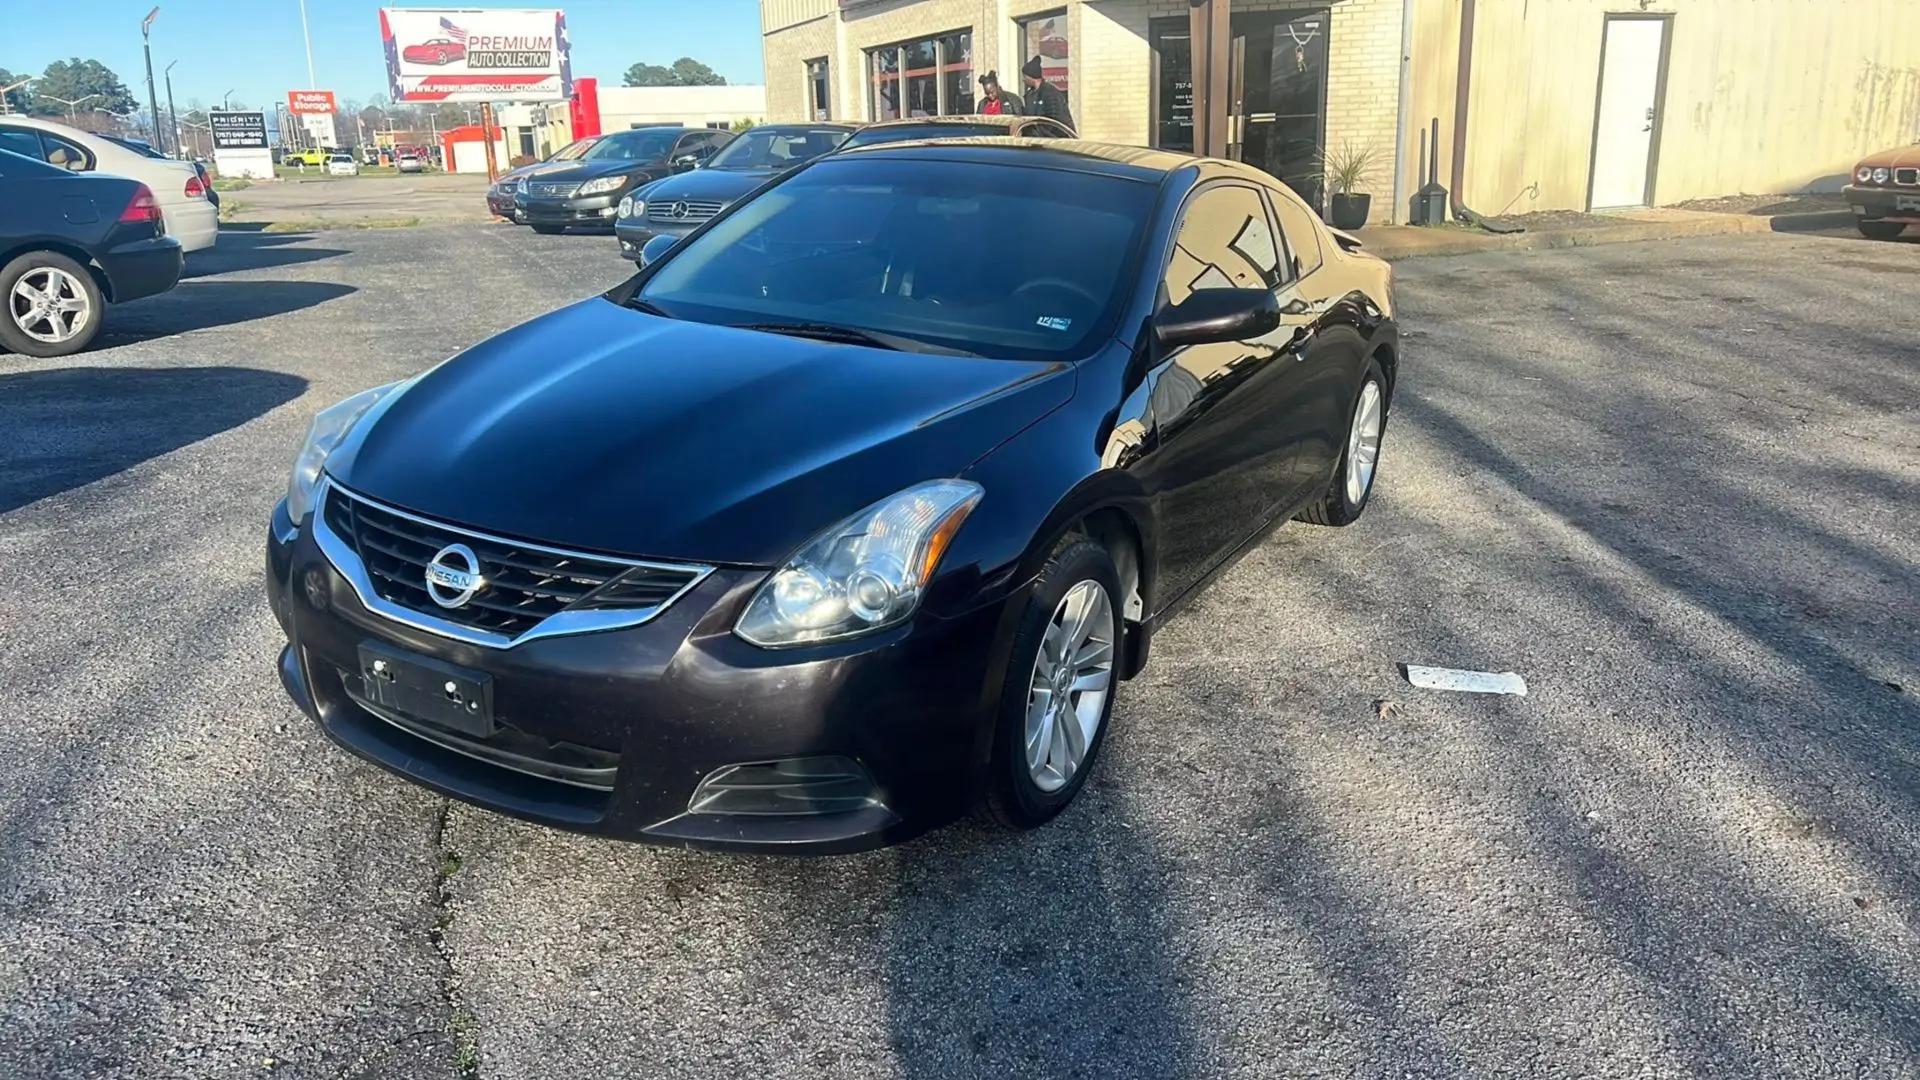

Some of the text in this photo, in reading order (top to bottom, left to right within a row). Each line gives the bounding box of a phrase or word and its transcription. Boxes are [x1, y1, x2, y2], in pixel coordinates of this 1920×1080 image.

[468, 36, 552, 50] PREMIUM
[469, 52, 549, 66] AUTO COLLECTION
[296, 93, 327, 102] Public
[294, 101, 331, 112] Storage
[426, 563, 471, 588] NISSAN
